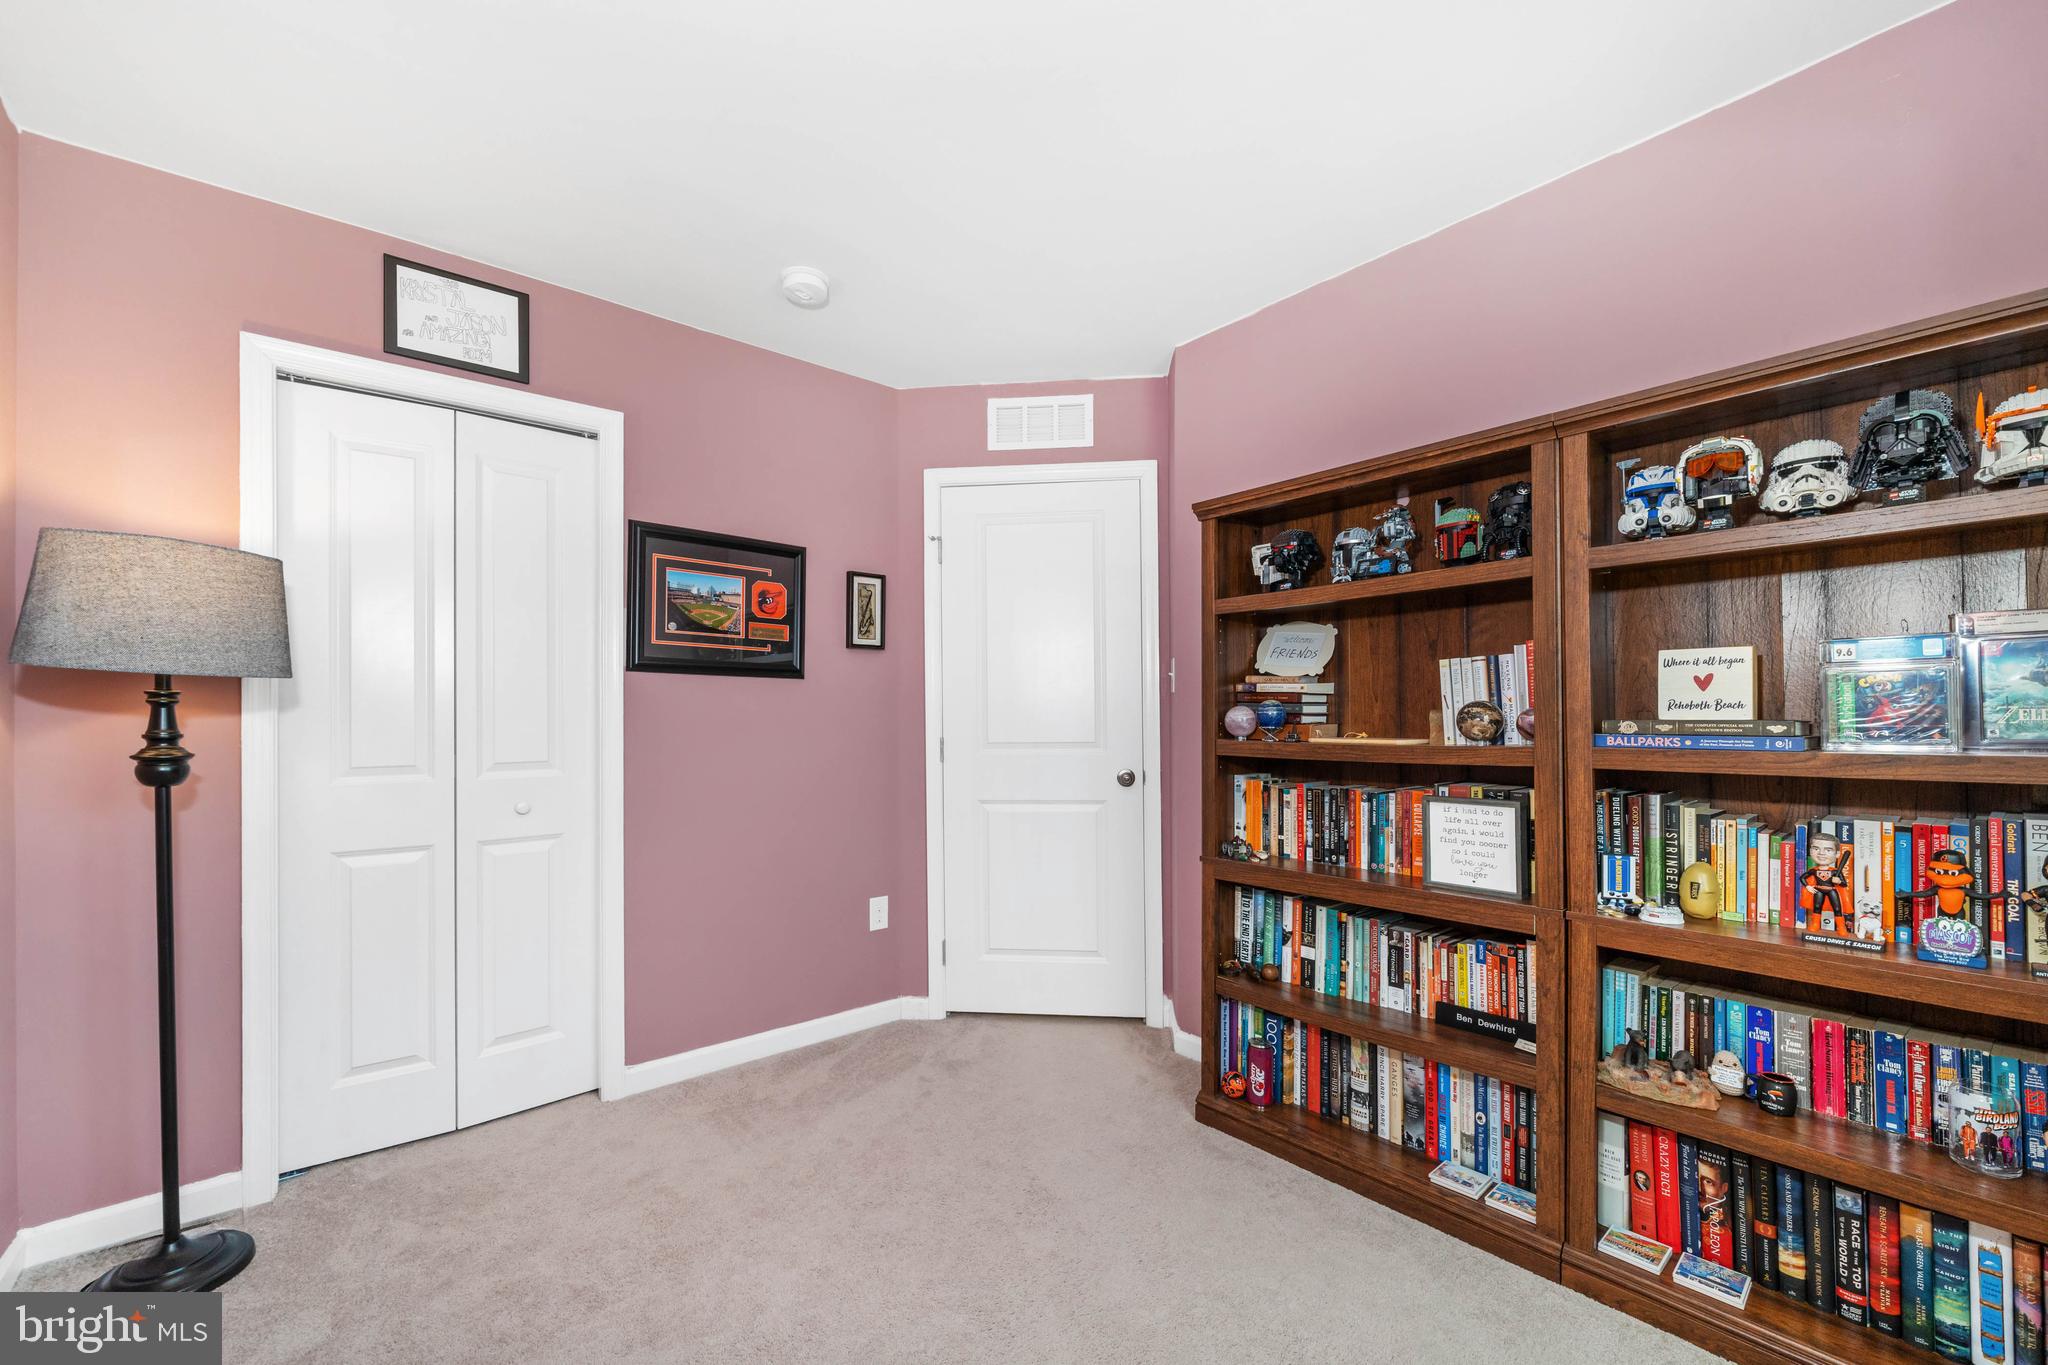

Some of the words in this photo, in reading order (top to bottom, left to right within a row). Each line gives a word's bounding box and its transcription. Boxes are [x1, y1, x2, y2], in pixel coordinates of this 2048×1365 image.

[1270, 646, 1319, 659] FRIENDS
[1836, 647, 1853, 657] 9.6
[1663, 657, 1691, 668] Where
[1692, 658, 1700, 666] it
[1702, 656, 1717, 666] all
[1719, 656, 1746, 669] began
[1667, 698, 1713, 712] Rehoboth
[1714, 698, 1747, 711] Beach
[1606, 735, 1681, 747] BALLPARKS
[1413, 803, 1423, 836] COLLAPSE
[1462, 807, 1478, 815] had
[1480, 808, 1490, 816] to
[1493, 809, 1504, 817] do
[1596, 804, 1604, 834] MEASURE
[1612, 797, 1620, 826] DUELING
[1632, 806, 1640, 826] GOD'S
[1444, 816, 1462, 824] life
[1464, 817, 1479, 825] all
[1482, 819, 1503, 828] over
[1479, 829, 1505, 838] would
[1597, 834, 1604, 843] OF
[1613, 828, 1621, 846] WITH
[1632, 826, 1640, 846] DOUBLE
[1990, 821, 2001, 846] crucial
[2006, 823, 2017, 854] Goldratt
[2031, 824, 2048, 852] BEN
[1440, 836, 1458, 844] find
[1460, 838, 1477, 847] you
[1478, 840, 1509, 849] sooner
[1884, 840, 1892, 854] New
[1471, 849, 1496, 859] could
[1665, 832, 1678, 890] STRINGER
[1450, 855, 1475, 867] love
[1474, 861, 1498, 873] you
[1884, 855, 1892, 881] Managers
[1974, 856, 1983, 874] POWER
[1458, 869, 1489, 880] longer
[1242, 899, 1250, 909] TO
[2007, 897, 2020, 923] GOAL
[1242, 909, 1250, 923] THE
[1265, 898, 1273, 939] TRUST
[1242, 923, 1250, 936] END
[1928, 929, 1973, 945] MASCOT
[1241, 940, 1250, 961] EARTH
[1804, 934, 1826, 943] CRUSH
[1826, 938, 1846, 946] DAVIS
[1852, 941, 1882, 951] SAMSON
[1456, 1013, 1473, 1024] Ben
[1477, 1018, 1516, 1035] Dewhirst
[1754, 1026, 1770, 1038] Tom
[1748, 1031, 1771, 1045] Clancy
[1785, 1038, 1802, 1049] Tom
[1825, 1032, 1833, 1046] Red
[1780, 1043, 1805, 1057] Clancy
[1825, 1048, 1833, 1071] Storm
[1883, 1058, 1902, 1070] Tom
[1914, 1060, 1925, 1075] Tom
[1877, 1063, 1903, 1078] Clancy
[1251, 1067, 1266, 1097] Coke
[1825, 1071, 1833, 1095] Rising
[1913, 1074, 1926, 1097] Clancy
[1854, 1095, 1862, 1113] Clancy
[1439, 1115, 1446, 1125] BY
[1974, 1111, 2019, 1125] BIRDLAND
[1439, 1124, 1447, 1148] CHOICE
[1659, 1136, 1670, 1170] CRAZY
[1680, 1144, 1689, 1159] First
[1699, 1149, 1726, 1161] ANDREW
[2027, 1137, 2039, 1160] Clancy
[1699, 1154, 1727, 1167] ROBERTS
[1682, 1167, 1690, 1179] Line
[1737, 1175, 1745, 1185] The
[1784, 1173, 1792, 1190] SONS
[1660, 1171, 1671, 1197] RICH
[1737, 1185, 1745, 1212] TRIUMPH
[1760, 1184, 1769, 1222] CAESARS
[1812, 1186, 1820, 1211] GENERAL
[1702, 1193, 1727, 1256] NAPOLEON
[1785, 1203, 1793, 1232] SOLDIERS
[1879, 1205, 1888, 1233] BENEATH
[1851, 1219, 1861, 1249] RACE
[1915, 1223, 1923, 1234] THE
[1933, 1227, 1946, 1236] ALL
[1949, 1232, 1964, 1240] THE
[1738, 1218, 1748, 1262] CHRISTIANITY
[1813, 1226, 1821, 1256] PRESIDENT
[1915, 1234, 1924, 1249] LAST
[1937, 1242, 1960, 1253] LIGHT
[1838, 1238, 1848, 1277] WORLD
[1879, 1240, 1888, 1266] SCARLET
[1916, 1249, 1924, 1270] GREEN
[1943, 1257, 1955, 1265] WE
[1852, 1267, 1862, 1290] TOP
[1879, 1266, 1888, 1279] SKY
[1916, 1270, 1925, 1291] VALLEY
[1934, 1267, 1965, 1281] CANNOT
[1815, 1273, 1823, 1297] BRANDS
[1944, 1284, 1958, 1293] SEE
